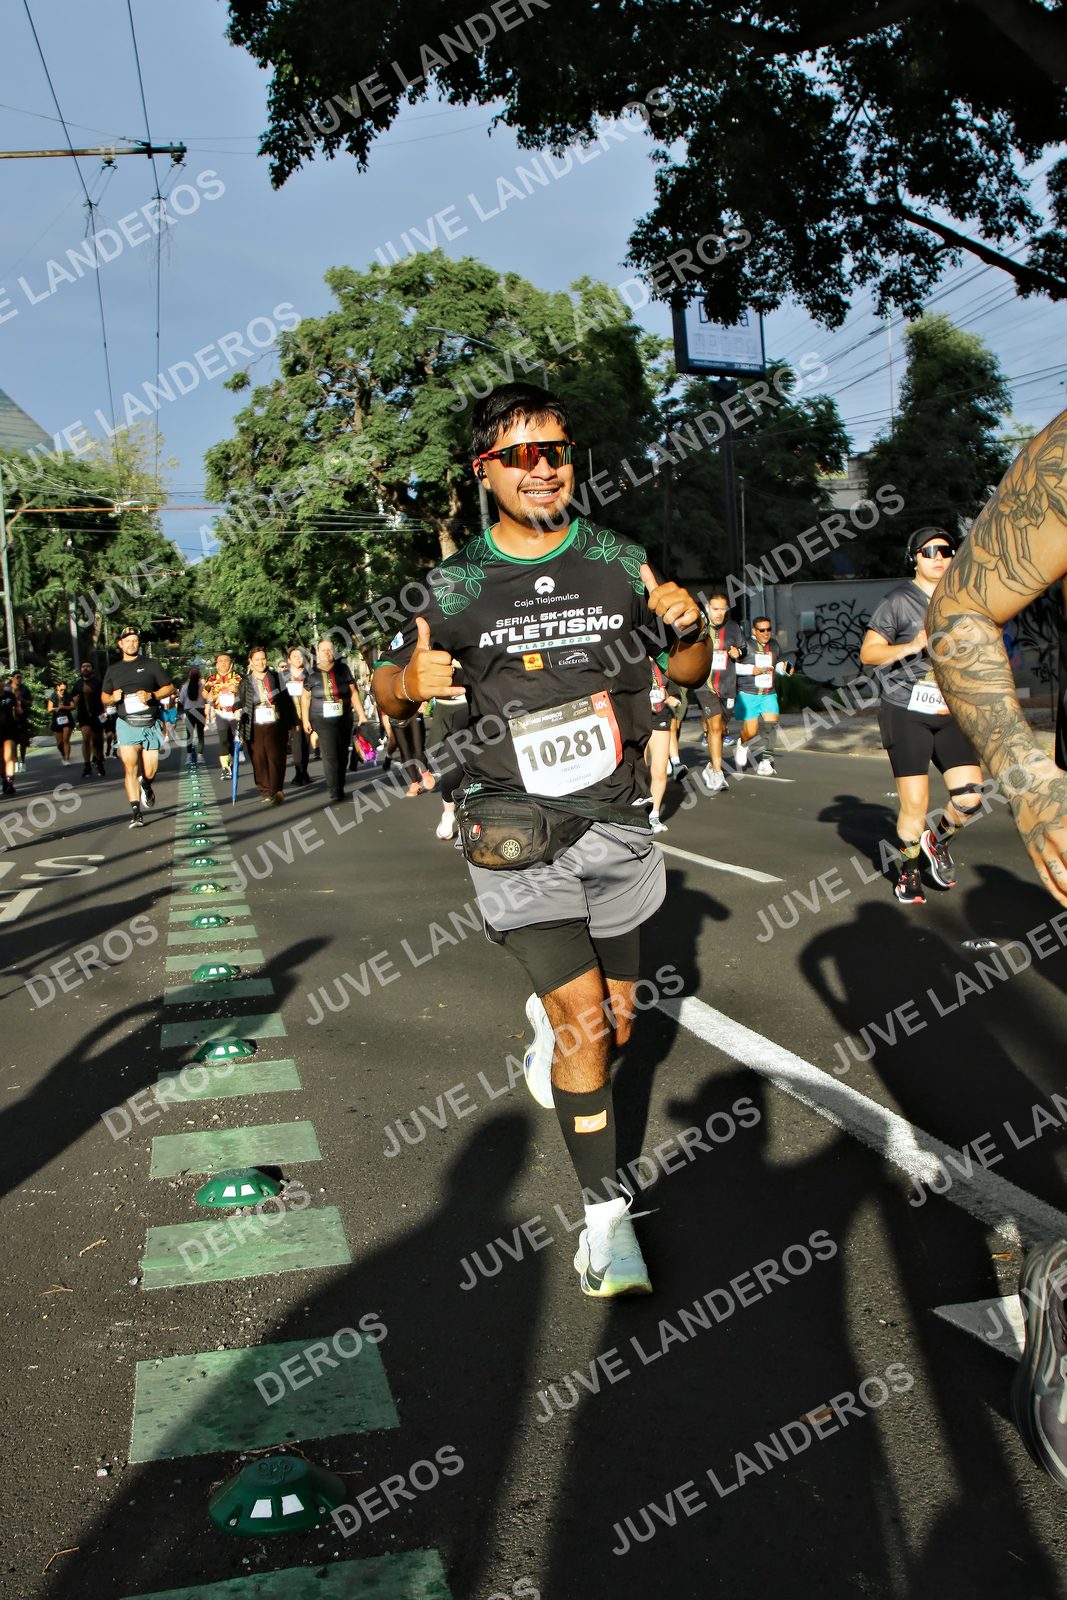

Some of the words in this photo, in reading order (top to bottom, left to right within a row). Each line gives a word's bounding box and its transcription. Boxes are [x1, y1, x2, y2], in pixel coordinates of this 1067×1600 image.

[514, 600, 534, 608] Caja
[536, 593, 579, 605] Tlajomulco
[816, 599, 856, 615] TOY
[496, 615, 537, 628] SERIAL
[540, 608, 584, 621] 5K-10K
[588, 606, 602, 614] DE
[479, 614, 624, 648] ATLETISMO
[518, 641, 554, 650] TLAJO
[561, 636, 591, 645] 2026
[594, 700, 608, 710] 10K
[522, 724, 606, 772] 10281
